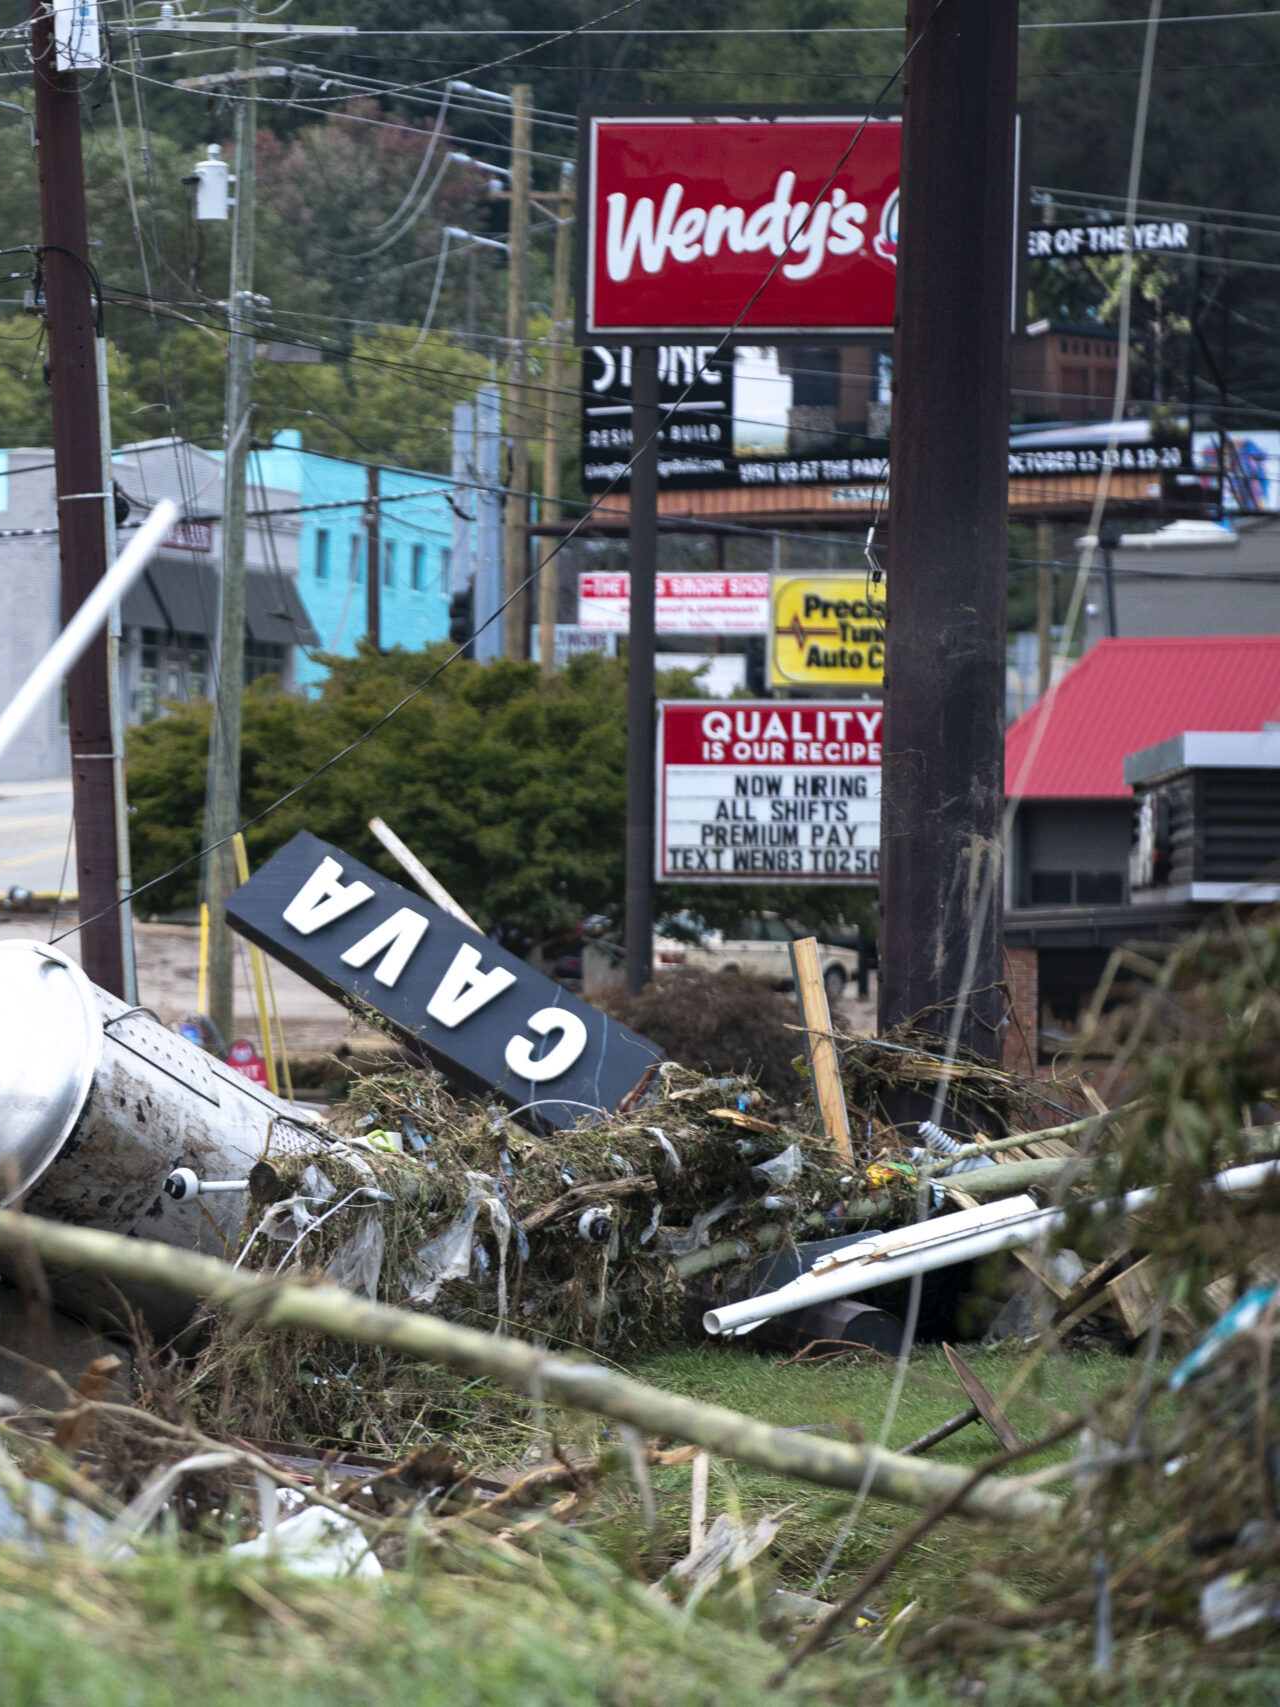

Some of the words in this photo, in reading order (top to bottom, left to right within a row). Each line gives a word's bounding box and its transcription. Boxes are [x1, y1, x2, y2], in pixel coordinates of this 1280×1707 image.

[607, 170, 868, 282] Wendy's
[1054, 228, 1085, 255] OF
[1086, 225, 1130, 252] THE
[1131, 222, 1190, 249] YEAR
[670, 424, 721, 443] BUILD
[738, 462, 775, 484] VISIT
[776, 460, 799, 481] US
[800, 459, 819, 481] AT
[820, 458, 850, 480] THE
[1122, 448, 1135, 469] &
[806, 644, 863, 668] Auto
[701, 710, 882, 743] QUALITY
[703, 742, 725, 761] IS
[732, 742, 785, 761] OUR
[793, 743, 882, 762] RECIPE
[734, 774, 783, 797] NOW
[794, 775, 868, 798] HIRING
[715, 799, 757, 821] ALL
[771, 800, 849, 822] SHIFTS
[700, 824, 799, 846] PREMIUM
[811, 825, 857, 847] PAY
[669, 849, 725, 871] TEXT
[733, 849, 803, 872] WEN83
[282, 855, 588, 1083] CAVA
